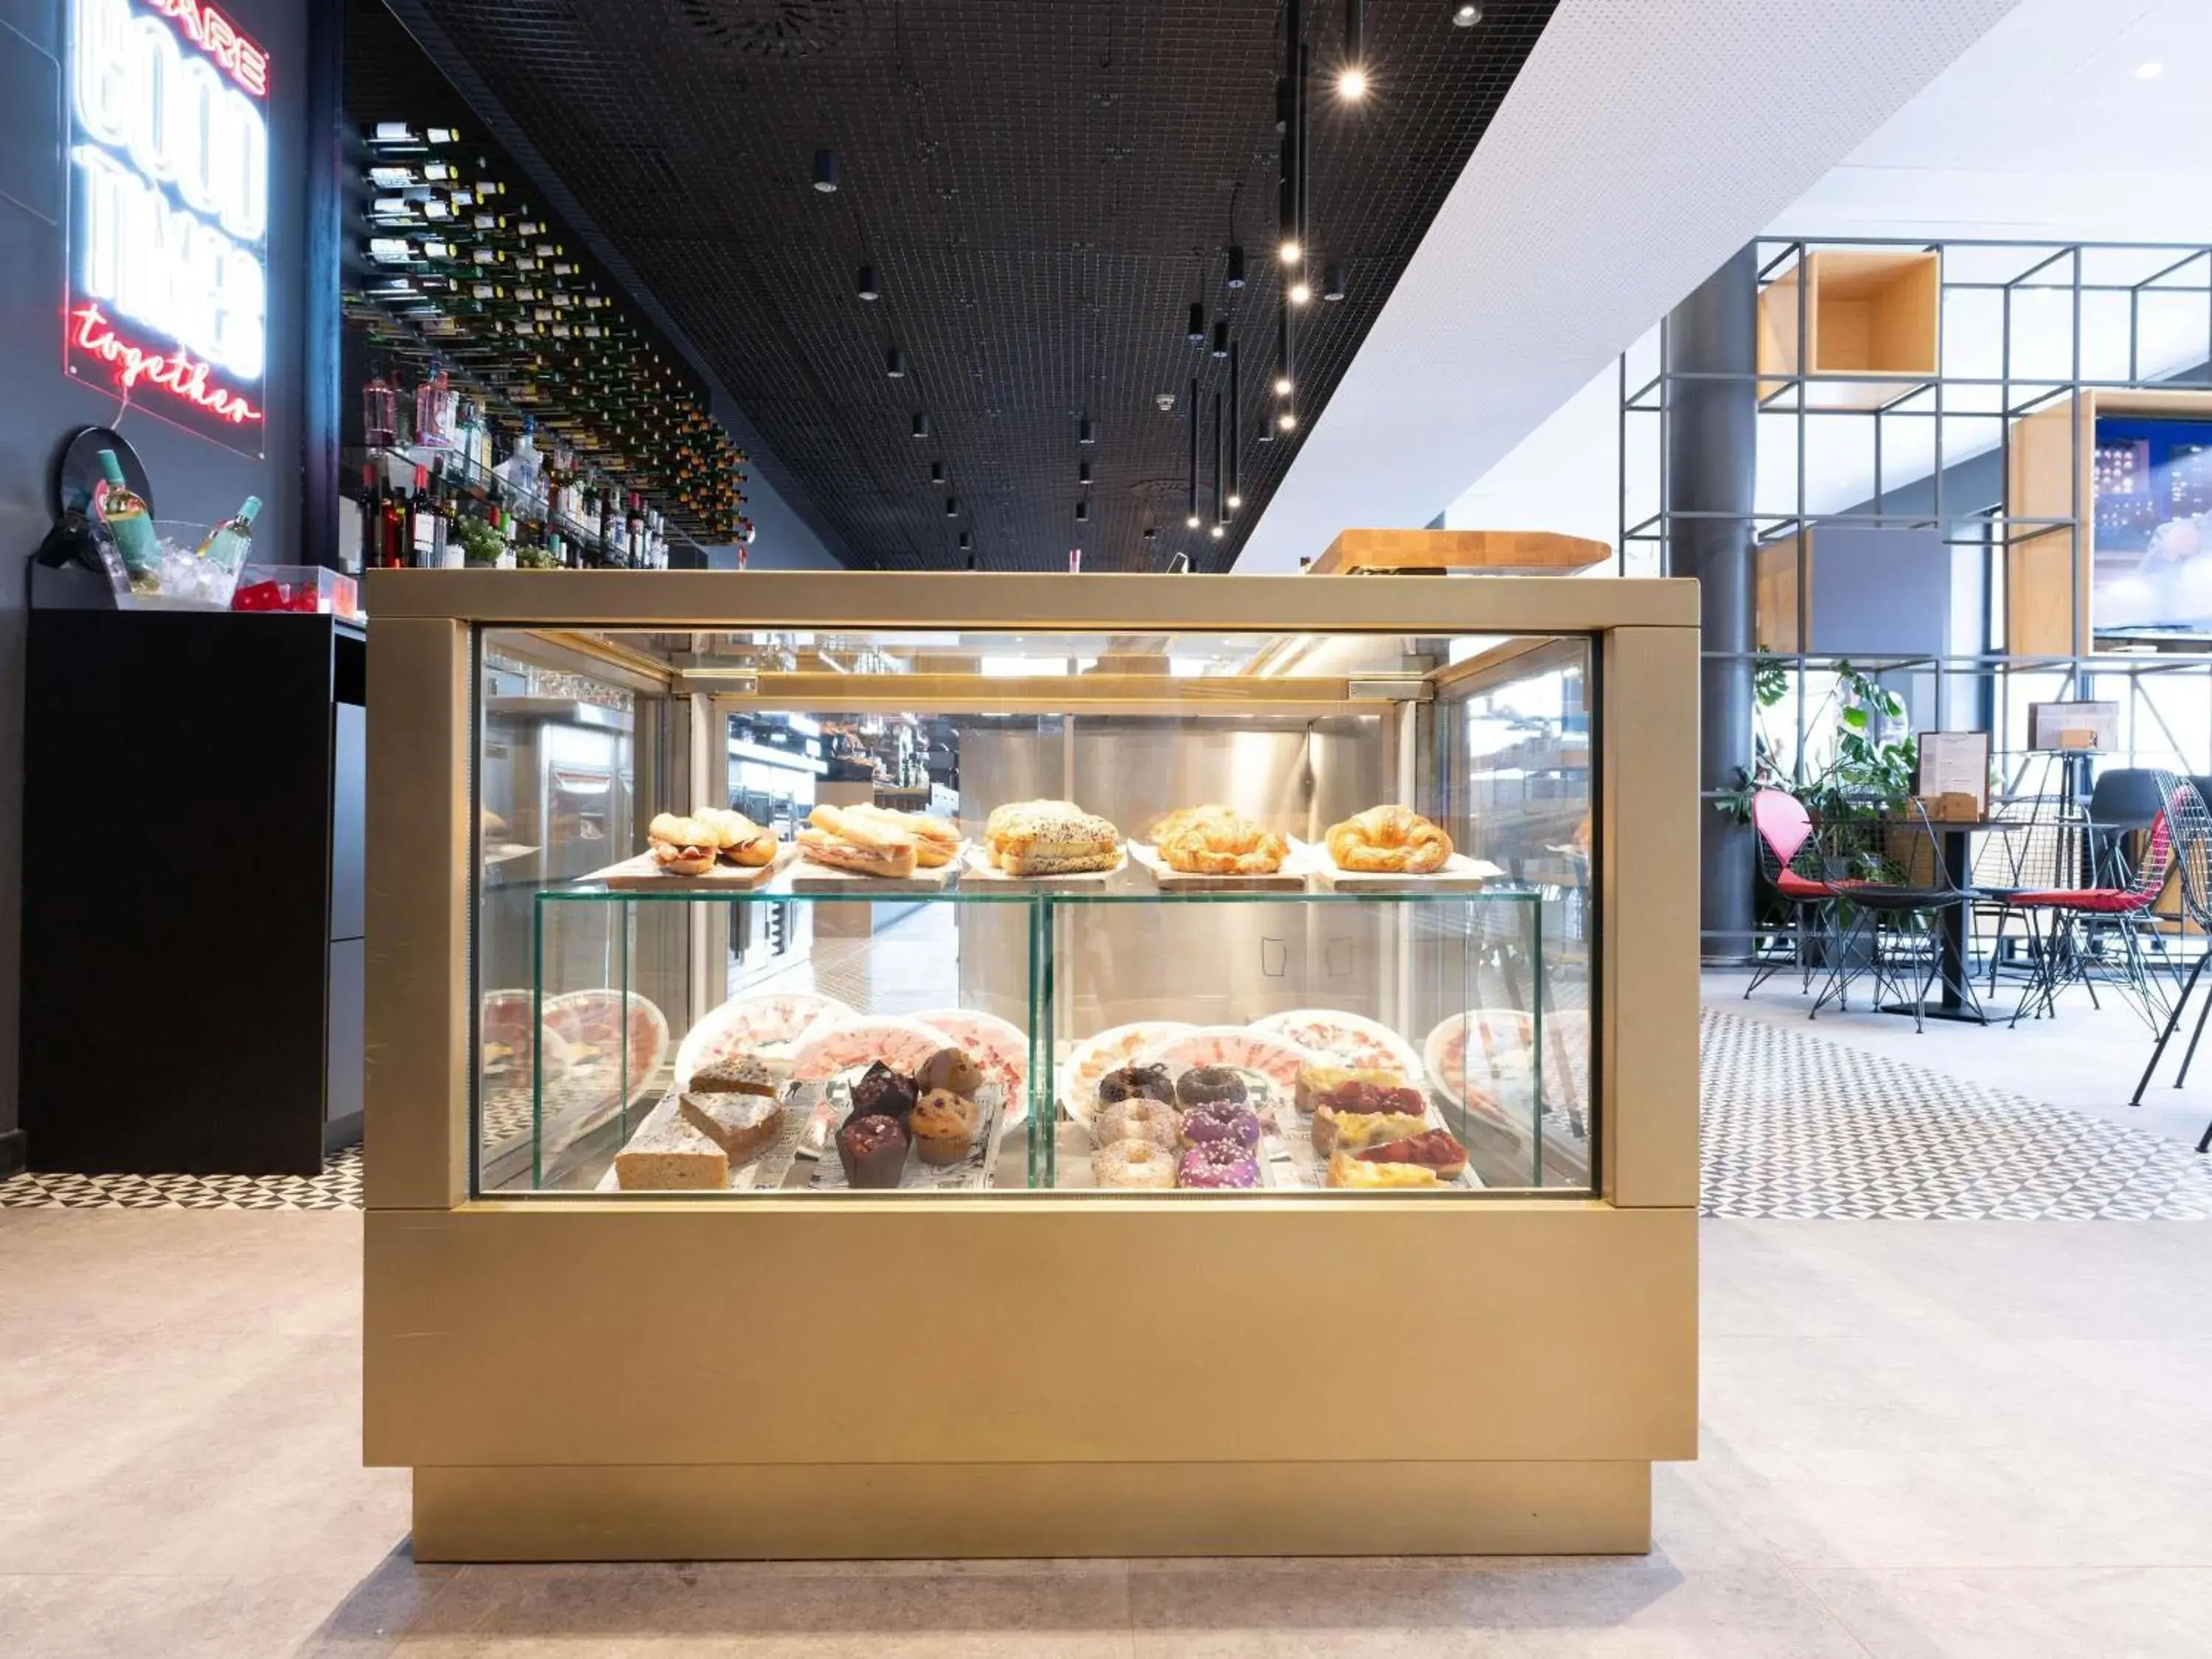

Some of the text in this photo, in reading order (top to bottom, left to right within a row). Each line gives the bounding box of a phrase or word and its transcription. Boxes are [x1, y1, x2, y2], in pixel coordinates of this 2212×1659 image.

[150, 0, 267, 95] ARE
[72, 0, 267, 240] GOOD
[72, 303, 261, 422] together
